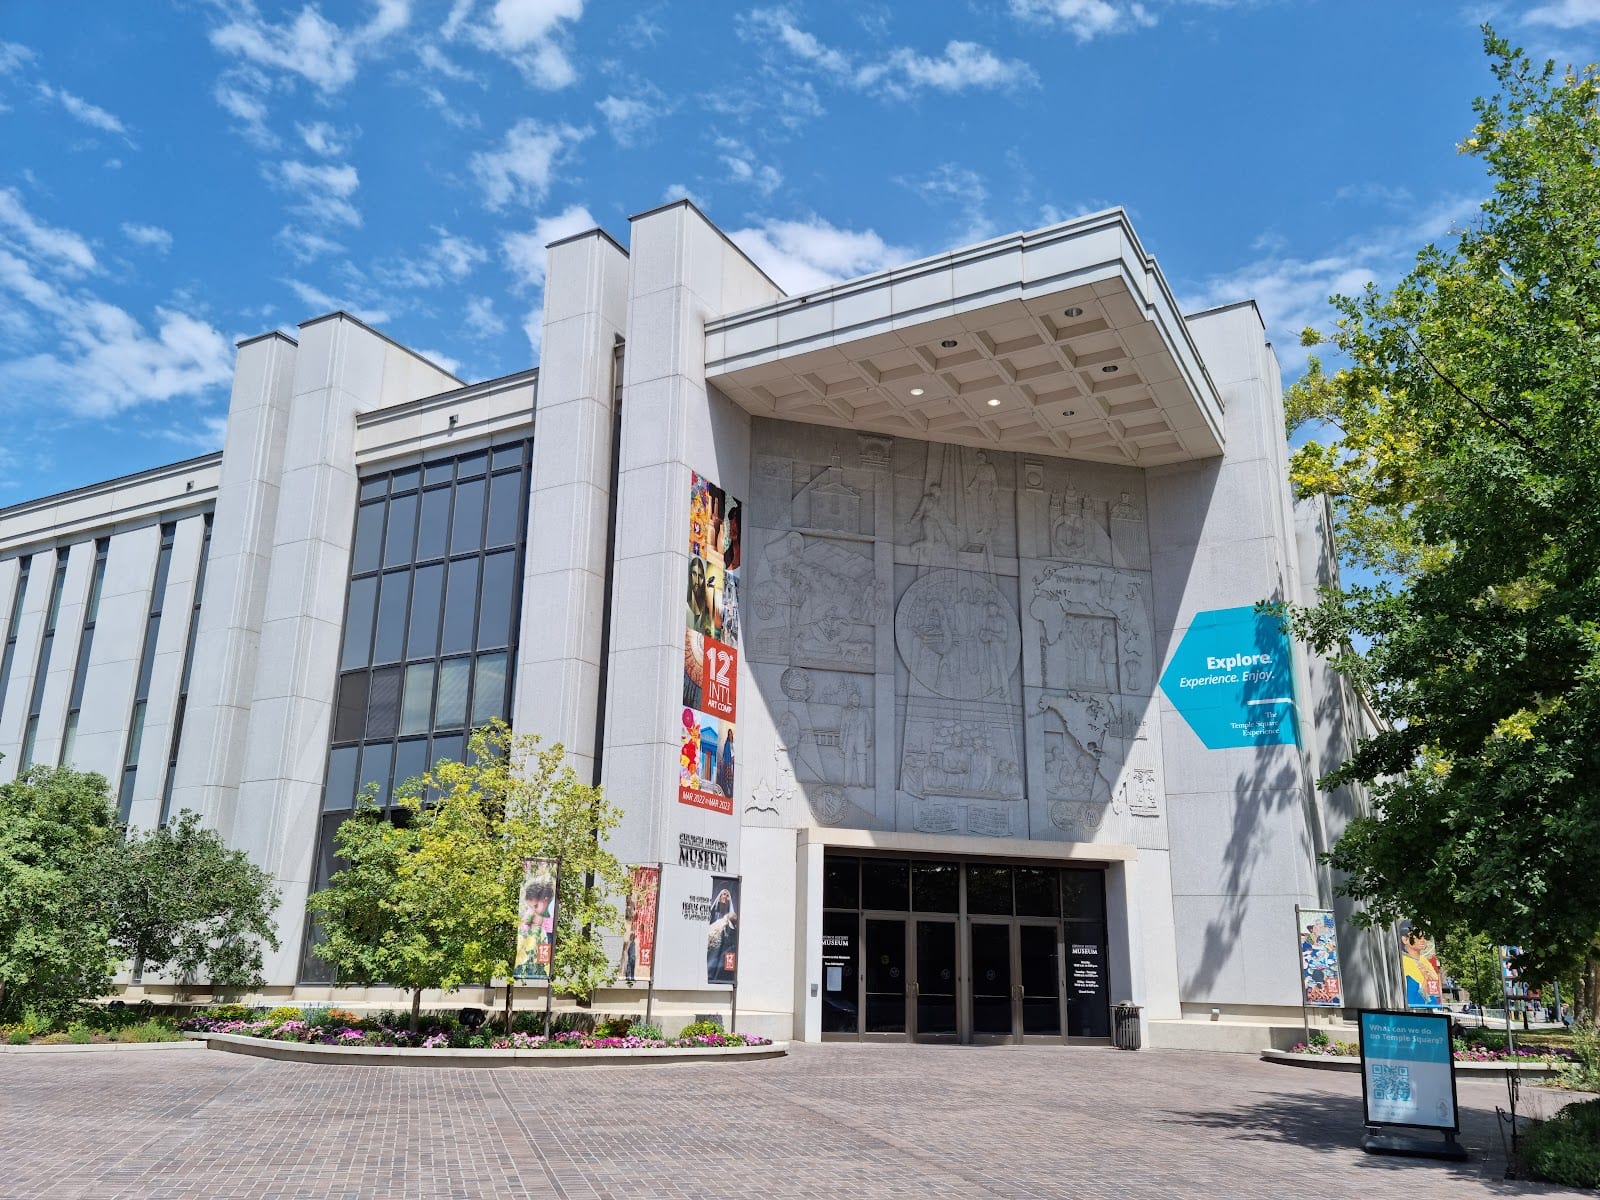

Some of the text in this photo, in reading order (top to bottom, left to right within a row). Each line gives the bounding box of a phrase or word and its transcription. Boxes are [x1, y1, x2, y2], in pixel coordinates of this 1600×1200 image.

[1206, 653, 1273, 671] Explore.
[1179, 671, 1275, 689] Experience. Enjoy.
[708, 699, 732, 714] ART COMP
[1231, 720, 1279, 730] Temple Square
[1242, 728, 1280, 737] Experience
[682, 791, 693, 801] MAR
[693, 794, 705, 804] 2022
[709, 798, 718, 808] MAR
[679, 846, 727, 869] MUSEUM
[1369, 1024, 1390, 1032] What
[1382, 1034, 1411, 1042] Temple
[1412, 1036, 1444, 1045] Square?
